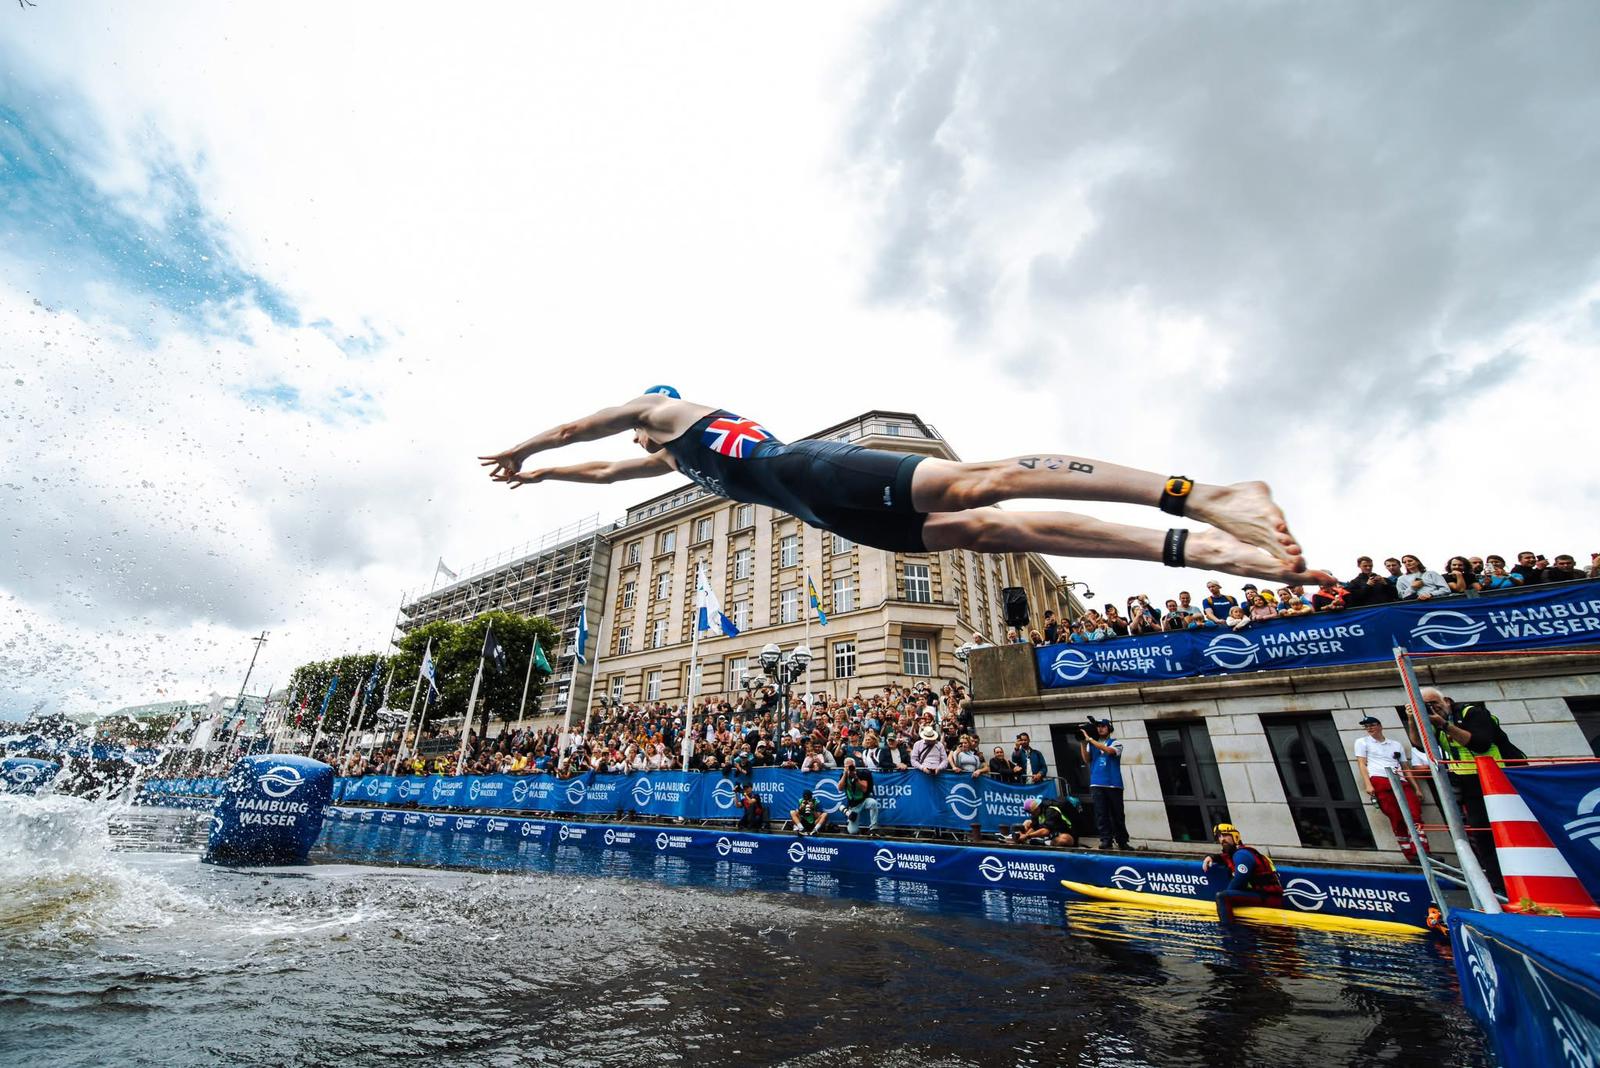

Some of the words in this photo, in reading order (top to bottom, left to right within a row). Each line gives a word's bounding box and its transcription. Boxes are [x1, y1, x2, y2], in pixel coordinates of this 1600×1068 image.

[1495, 617, 1600, 638] WASSER
[1261, 624, 1364, 645] HAMBURG
[1095, 645, 1173, 661] HAMBURG
[1265, 640, 1344, 658] WASSER
[1097, 658, 1156, 673] WASSER
[654, 782, 690, 792] HAMBURG
[751, 782, 785, 793] MBURG
[529, 790, 548, 798] WASSER
[587, 792, 608, 800] WASSER
[654, 792, 680, 802] WASSER
[235, 798, 309, 814] HAMBURG
[986, 803, 1032, 817] WASSE
[239, 812, 297, 826] WASSER
[670, 835, 692, 843] HAMBURG
[732, 840, 759, 848] HAMBURG
[807, 846, 839, 855] HAMBURG
[807, 853, 831, 862] WASSER
[897, 852, 936, 863] HAMBURG
[897, 861, 927, 871] WASSER
[1007, 861, 1056, 873] HAMBURG
[1008, 870, 1046, 881] WASSER
[1147, 872, 1209, 886] HAMBURG
[1149, 882, 1197, 895] WASSER
[1328, 885, 1411, 903] HAMBURG
[1332, 897, 1395, 913] WASSER
